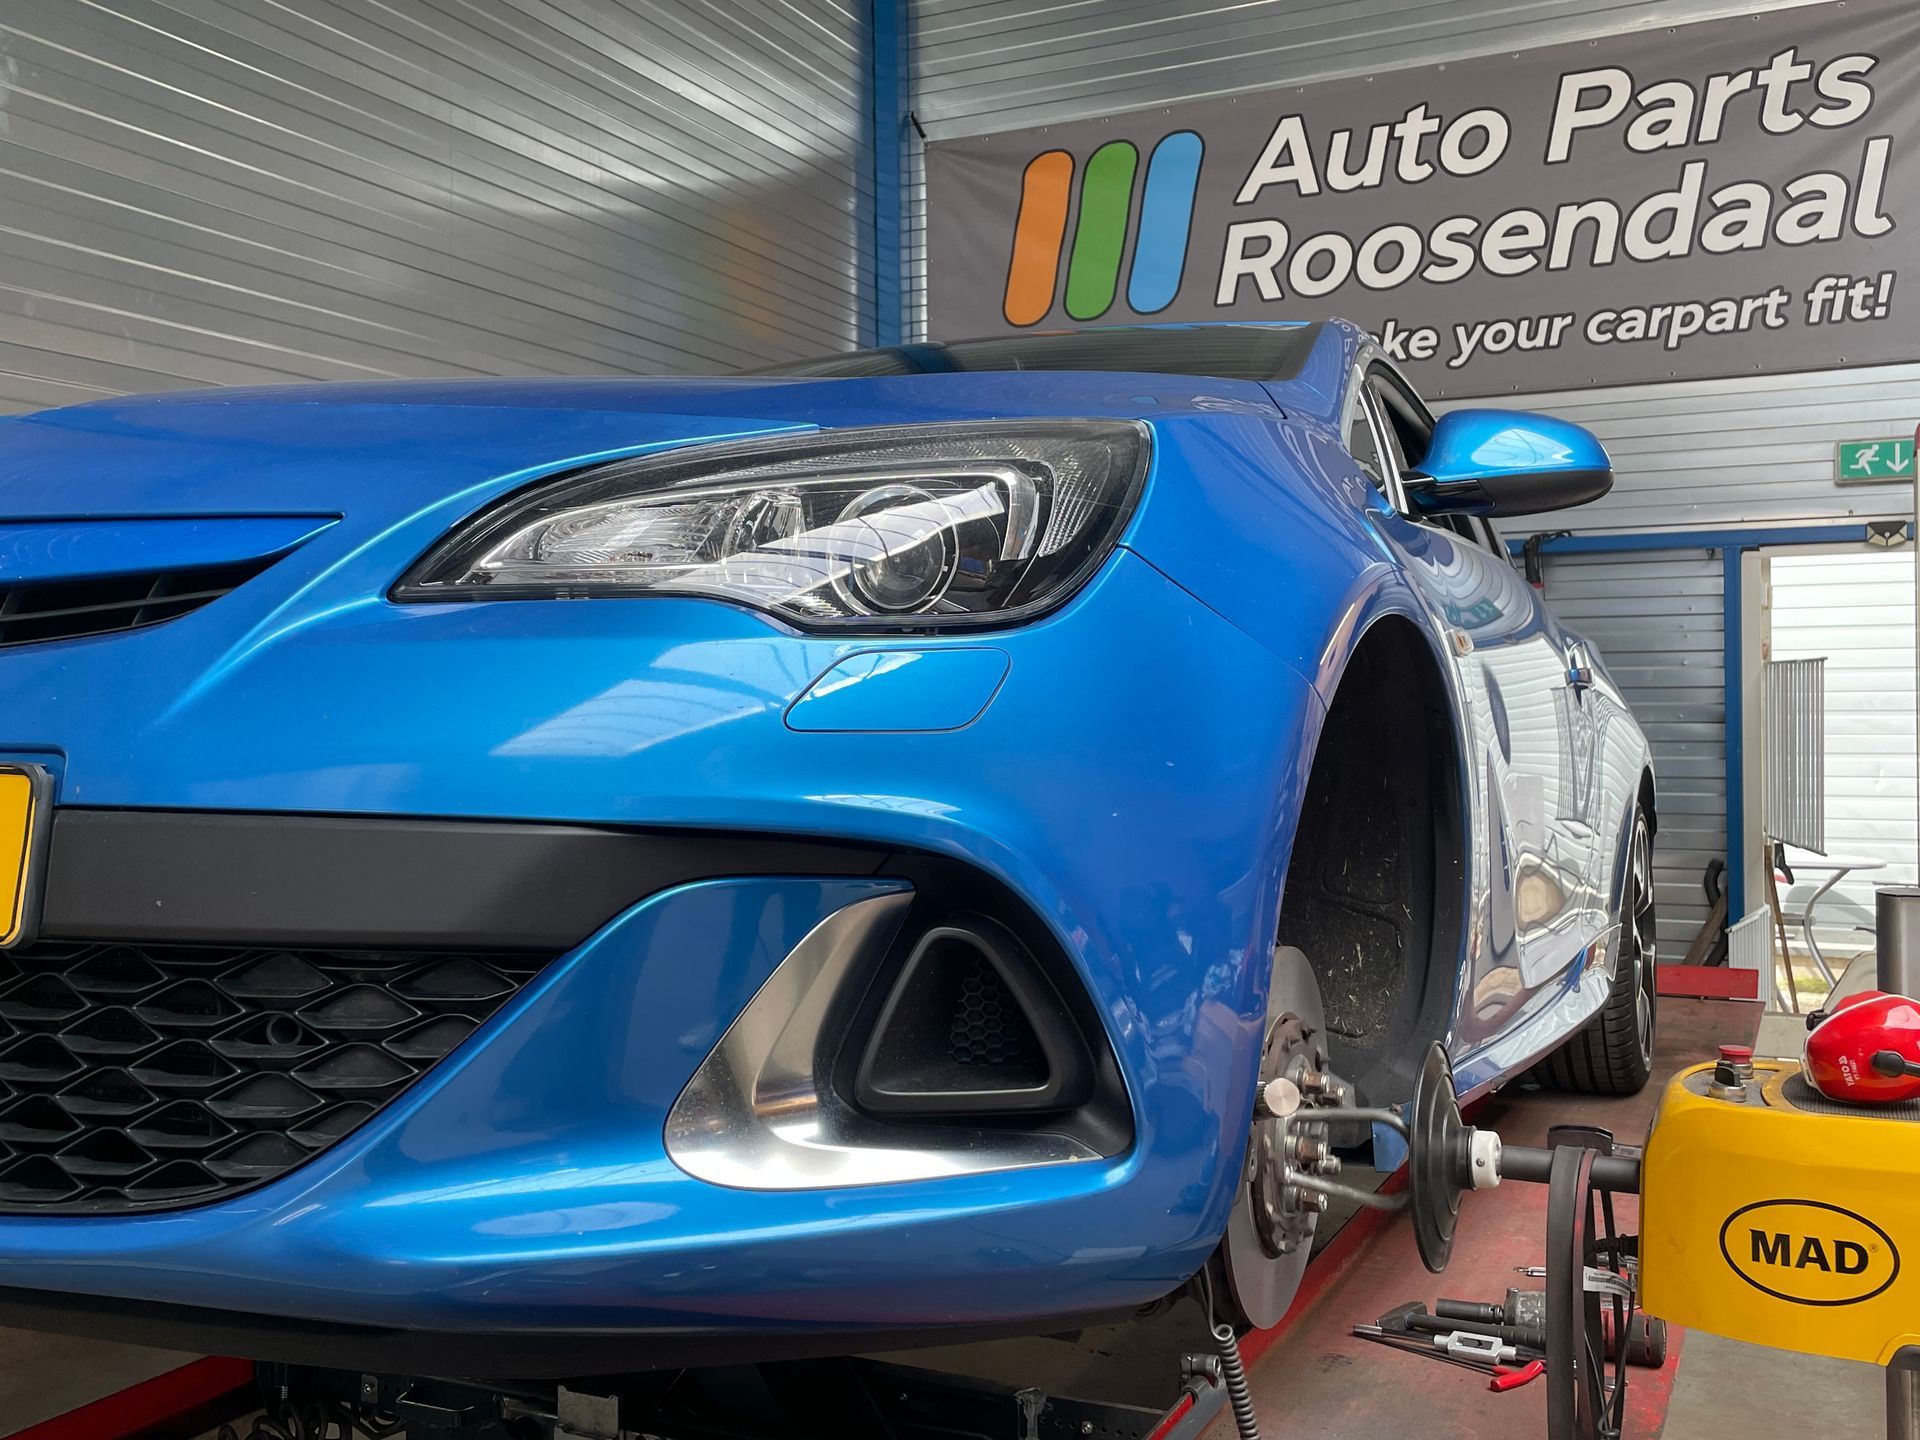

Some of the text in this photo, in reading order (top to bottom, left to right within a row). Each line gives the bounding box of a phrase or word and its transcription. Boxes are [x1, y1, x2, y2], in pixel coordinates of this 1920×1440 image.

[1235, 48, 1877, 204] Auto Parts
[1215, 137, 1893, 306] Roosendaal
[1371, 272, 1894, 368] ke your carpart fit!
[1841, 1065, 1855, 1087] YATO
[1748, 1228, 1869, 1275] MAD
